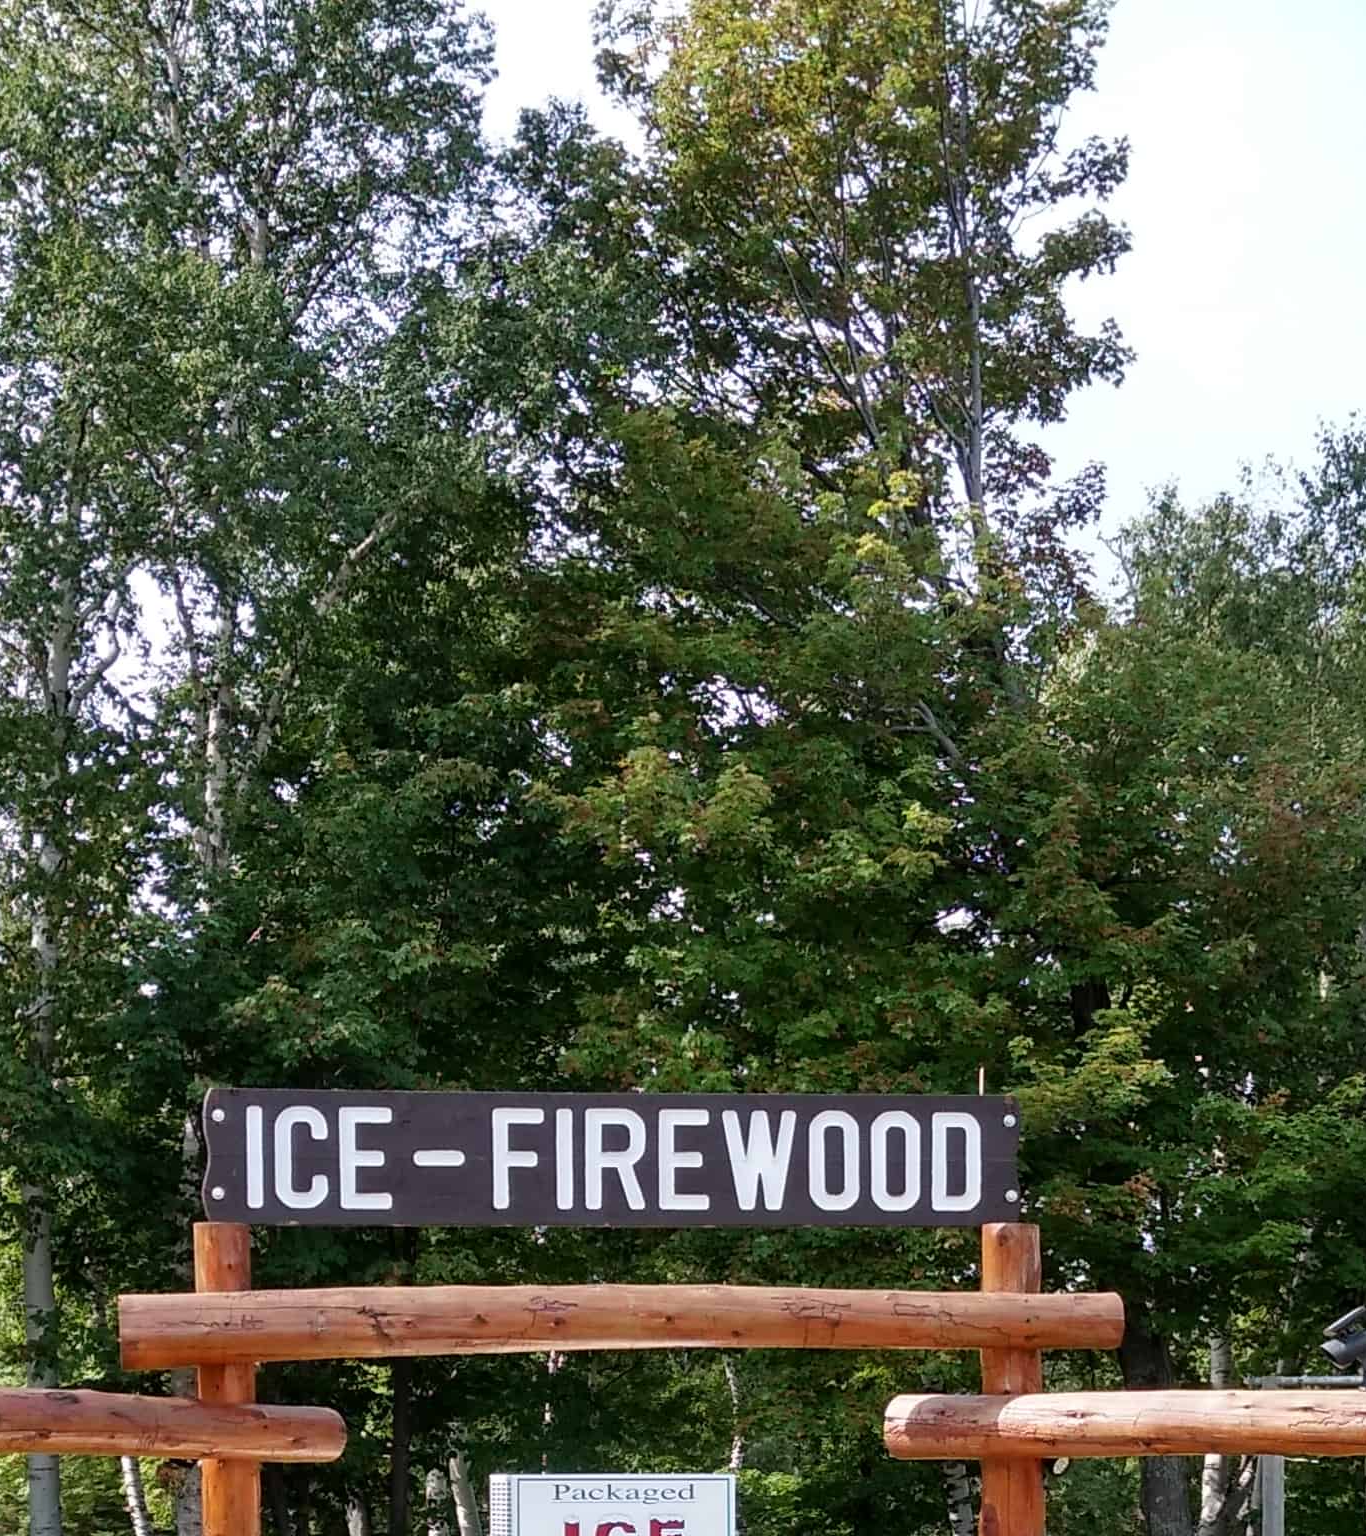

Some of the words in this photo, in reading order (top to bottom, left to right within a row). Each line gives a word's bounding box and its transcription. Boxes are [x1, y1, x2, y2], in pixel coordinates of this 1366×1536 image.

[246, 1105, 393, 1210] ICE
[492, 1108, 981, 1211] FIREWOOD
[552, 1484, 695, 1504] Packaged
